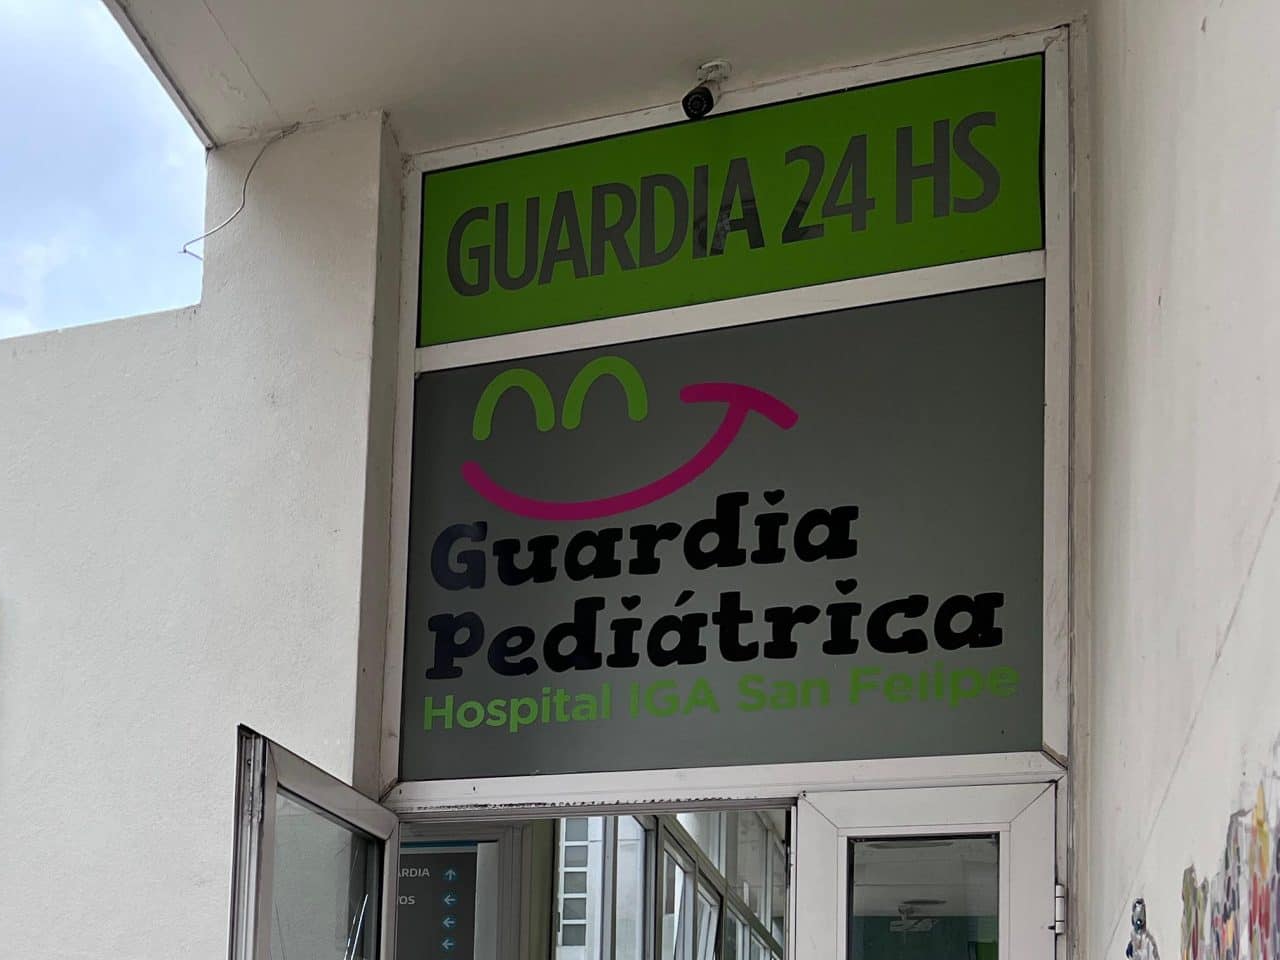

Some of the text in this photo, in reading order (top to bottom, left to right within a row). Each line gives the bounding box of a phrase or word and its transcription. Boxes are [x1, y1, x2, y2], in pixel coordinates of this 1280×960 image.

[446, 111, 1001, 297] GUARDIA 24 HS
[430, 489, 859, 591] Guardia
[425, 578, 1005, 680] Pediátrica
[423, 682, 612, 733] Hospital
[629, 676, 720, 719] IGA
[737, 672, 831, 712] San
